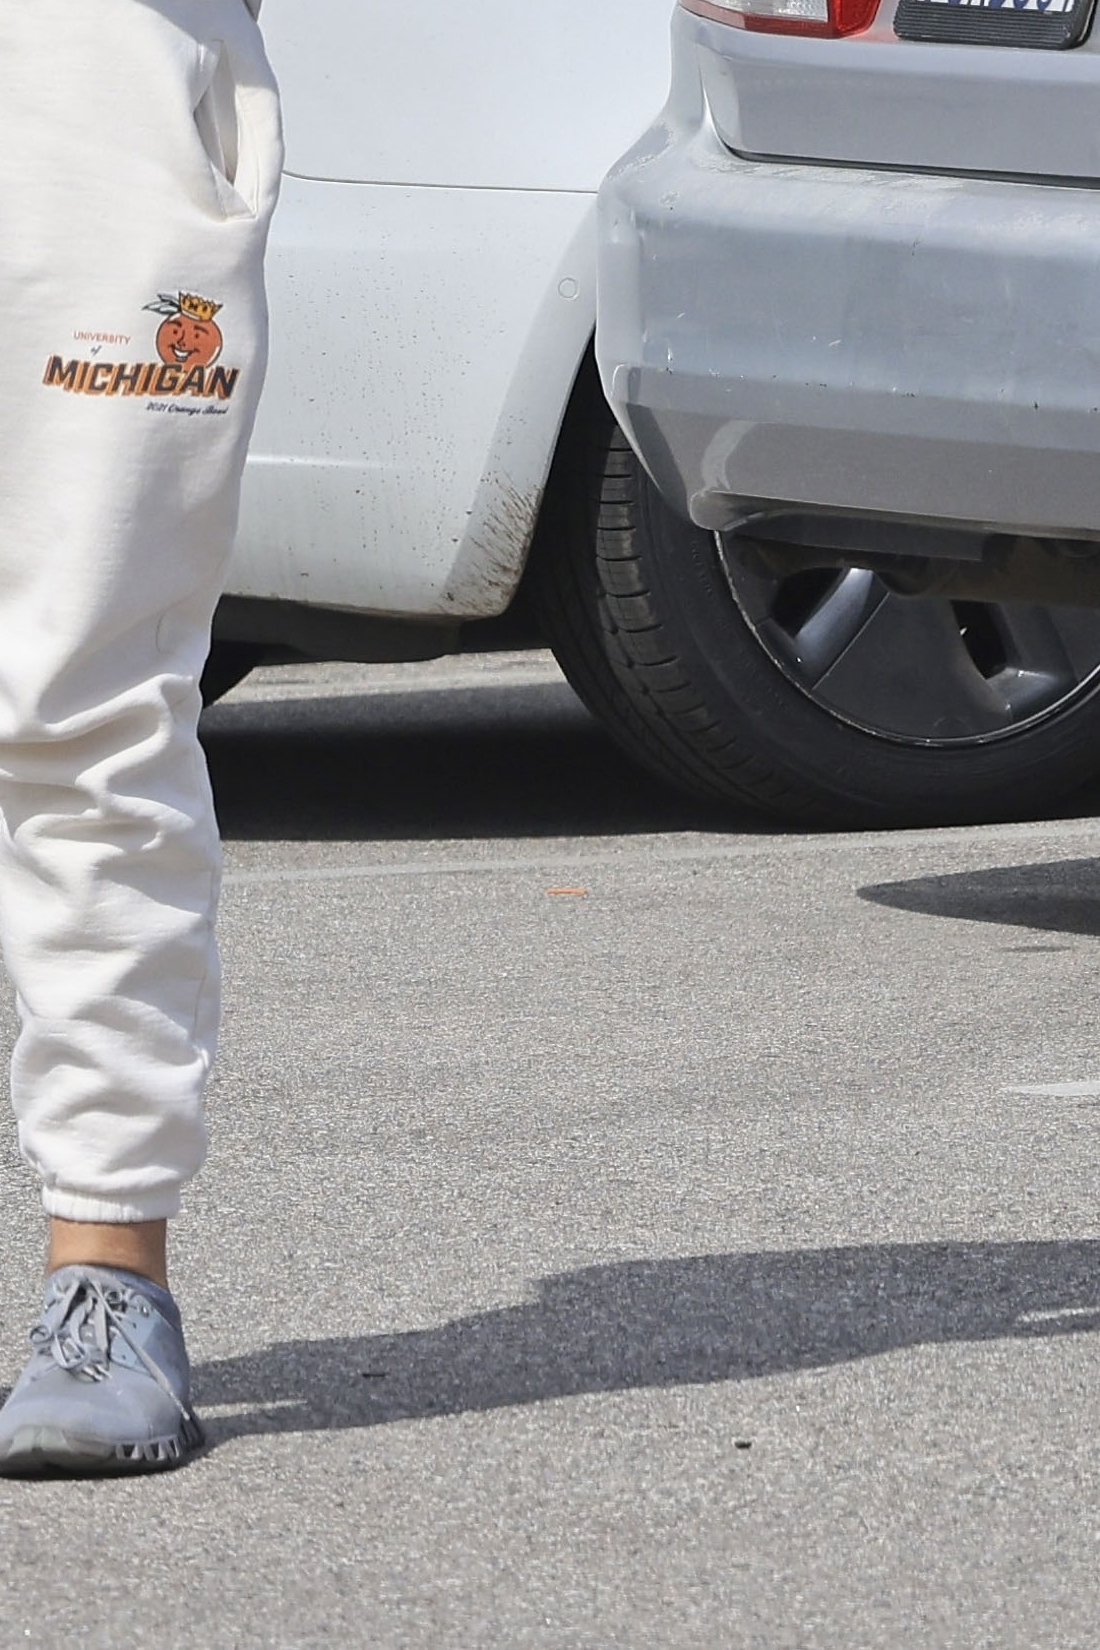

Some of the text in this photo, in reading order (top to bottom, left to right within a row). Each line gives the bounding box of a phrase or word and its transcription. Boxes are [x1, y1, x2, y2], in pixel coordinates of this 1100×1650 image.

[73, 330, 131, 345] UNIVERSITY
[90, 345, 102, 356] of
[42, 354, 241, 400] MICHIGAN
